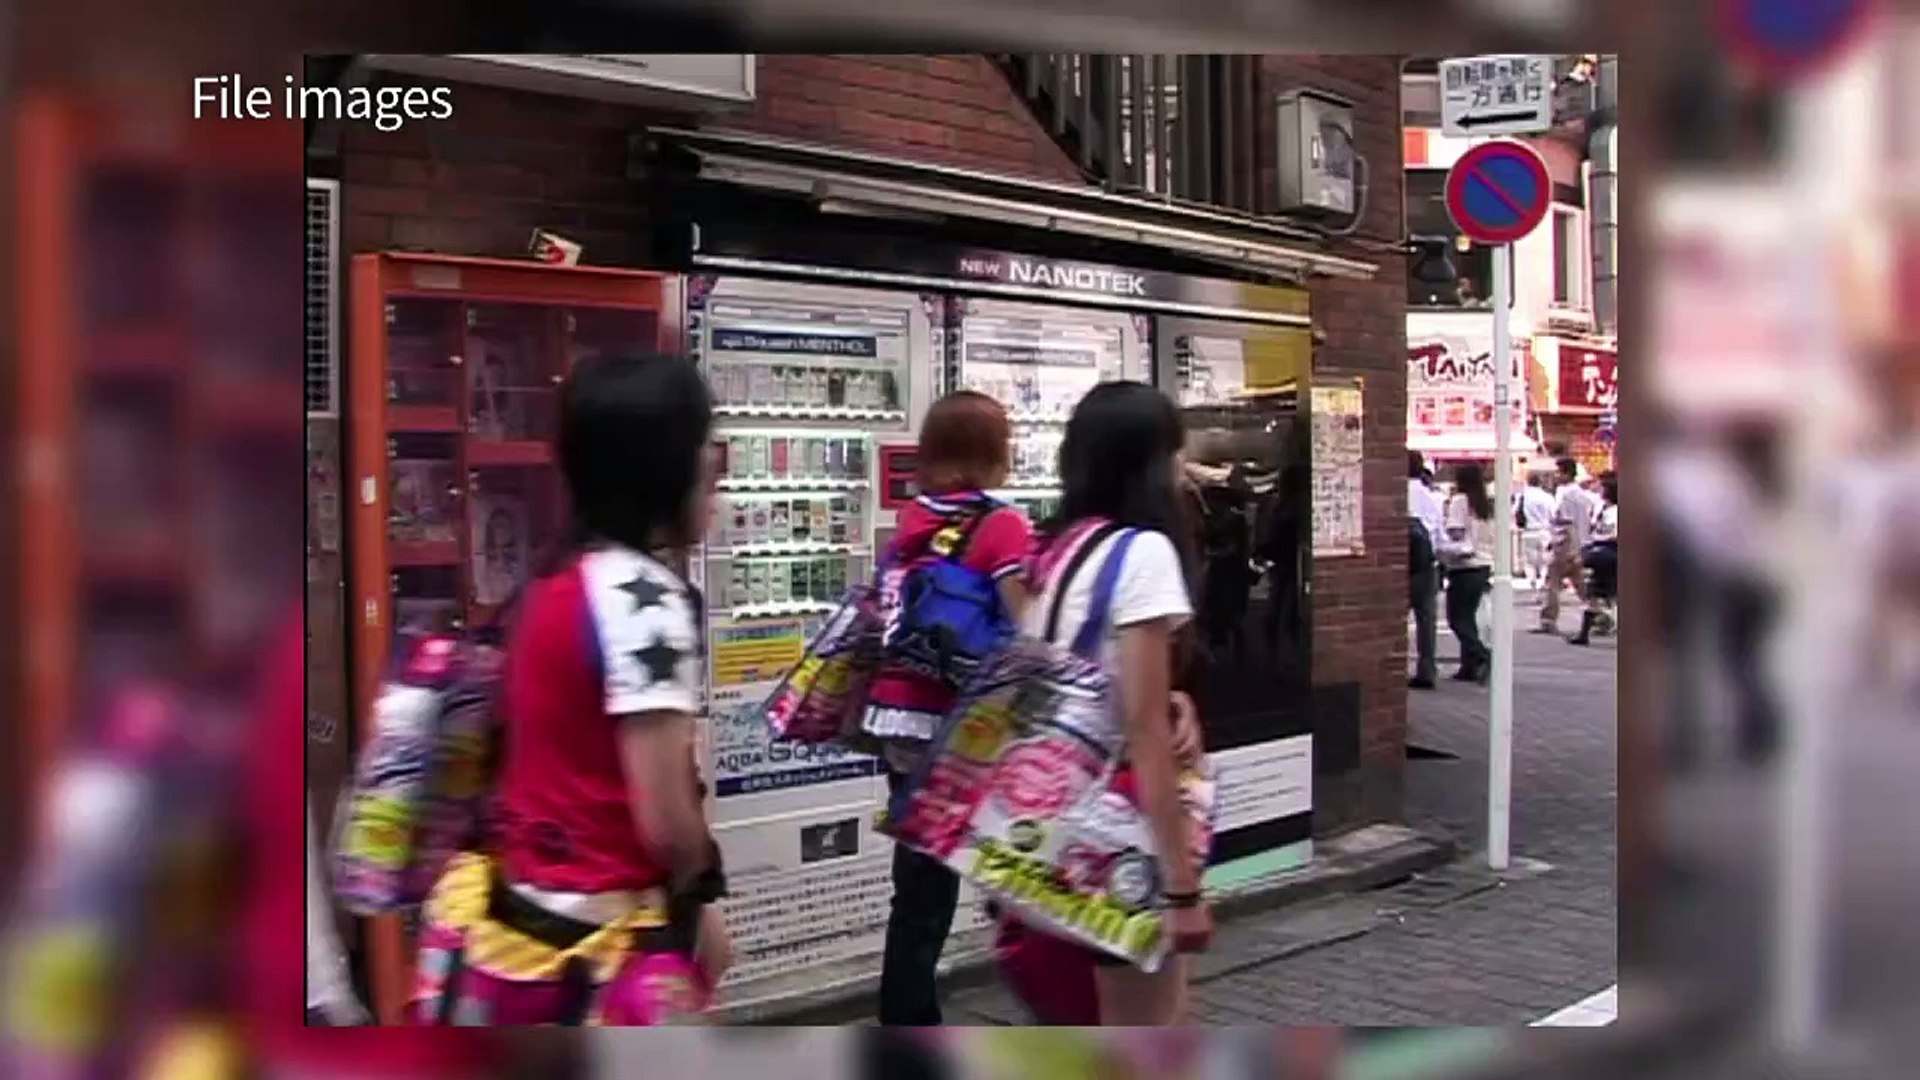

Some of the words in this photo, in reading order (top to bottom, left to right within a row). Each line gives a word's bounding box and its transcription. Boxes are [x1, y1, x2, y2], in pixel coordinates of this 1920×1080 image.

[1446, 82, 1542, 108] 一方通行
[960, 258, 1000, 275] NEW
[1009, 260, 1147, 296] NANOTEK
[715, 751, 763, 771] AQUA
